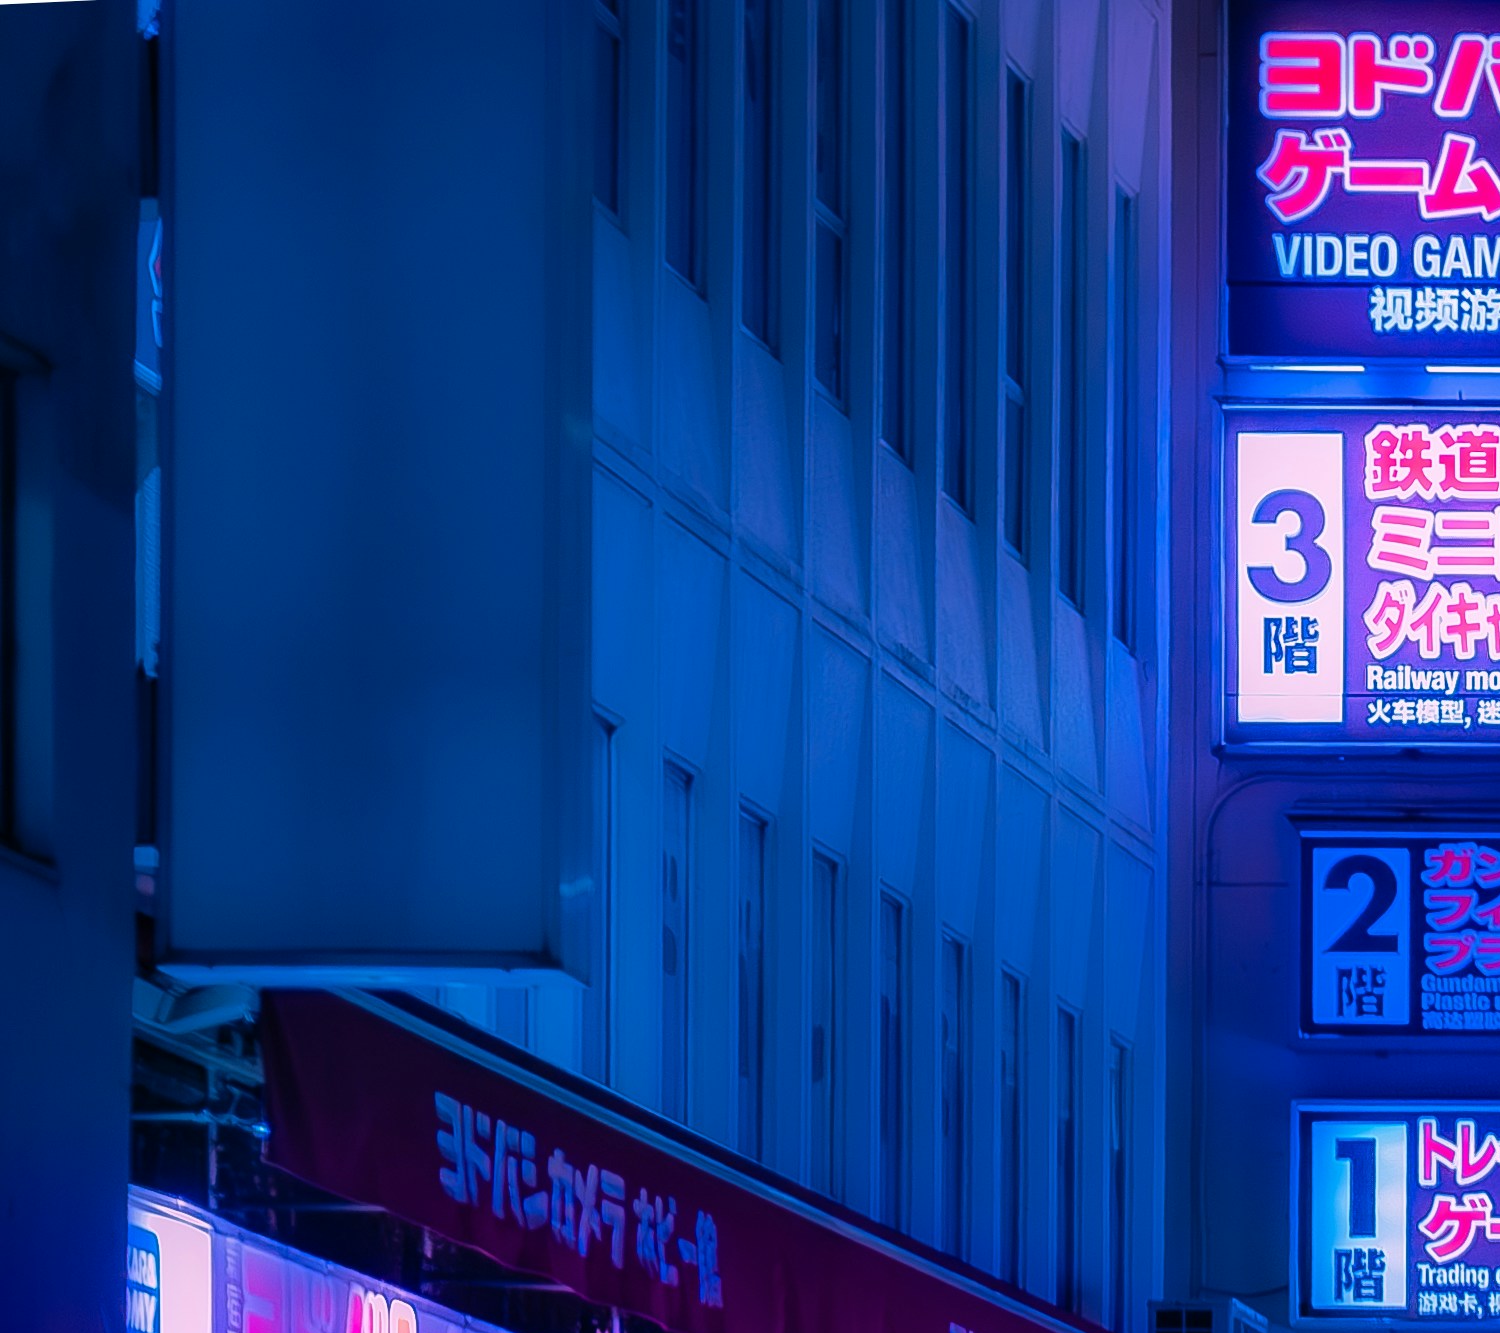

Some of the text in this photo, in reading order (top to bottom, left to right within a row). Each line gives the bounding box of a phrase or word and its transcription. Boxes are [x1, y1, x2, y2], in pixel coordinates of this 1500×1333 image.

[1272, 234, 1397, 279] VIDEO
[1247, 489, 1333, 604] 3
[1262, 616, 1319, 675] 階
[1367, 665, 1458, 694] Railway
[1322, 854, 1399, 953] 2
[1336, 966, 1388, 1018] 階
[434, 1090, 626, 1270] ヨドバシカメラ
[1335, 1137, 1378, 1239] 1
[1334, 1248, 1386, 1303] 階
[1416, 1263, 1490, 1290] Trading
